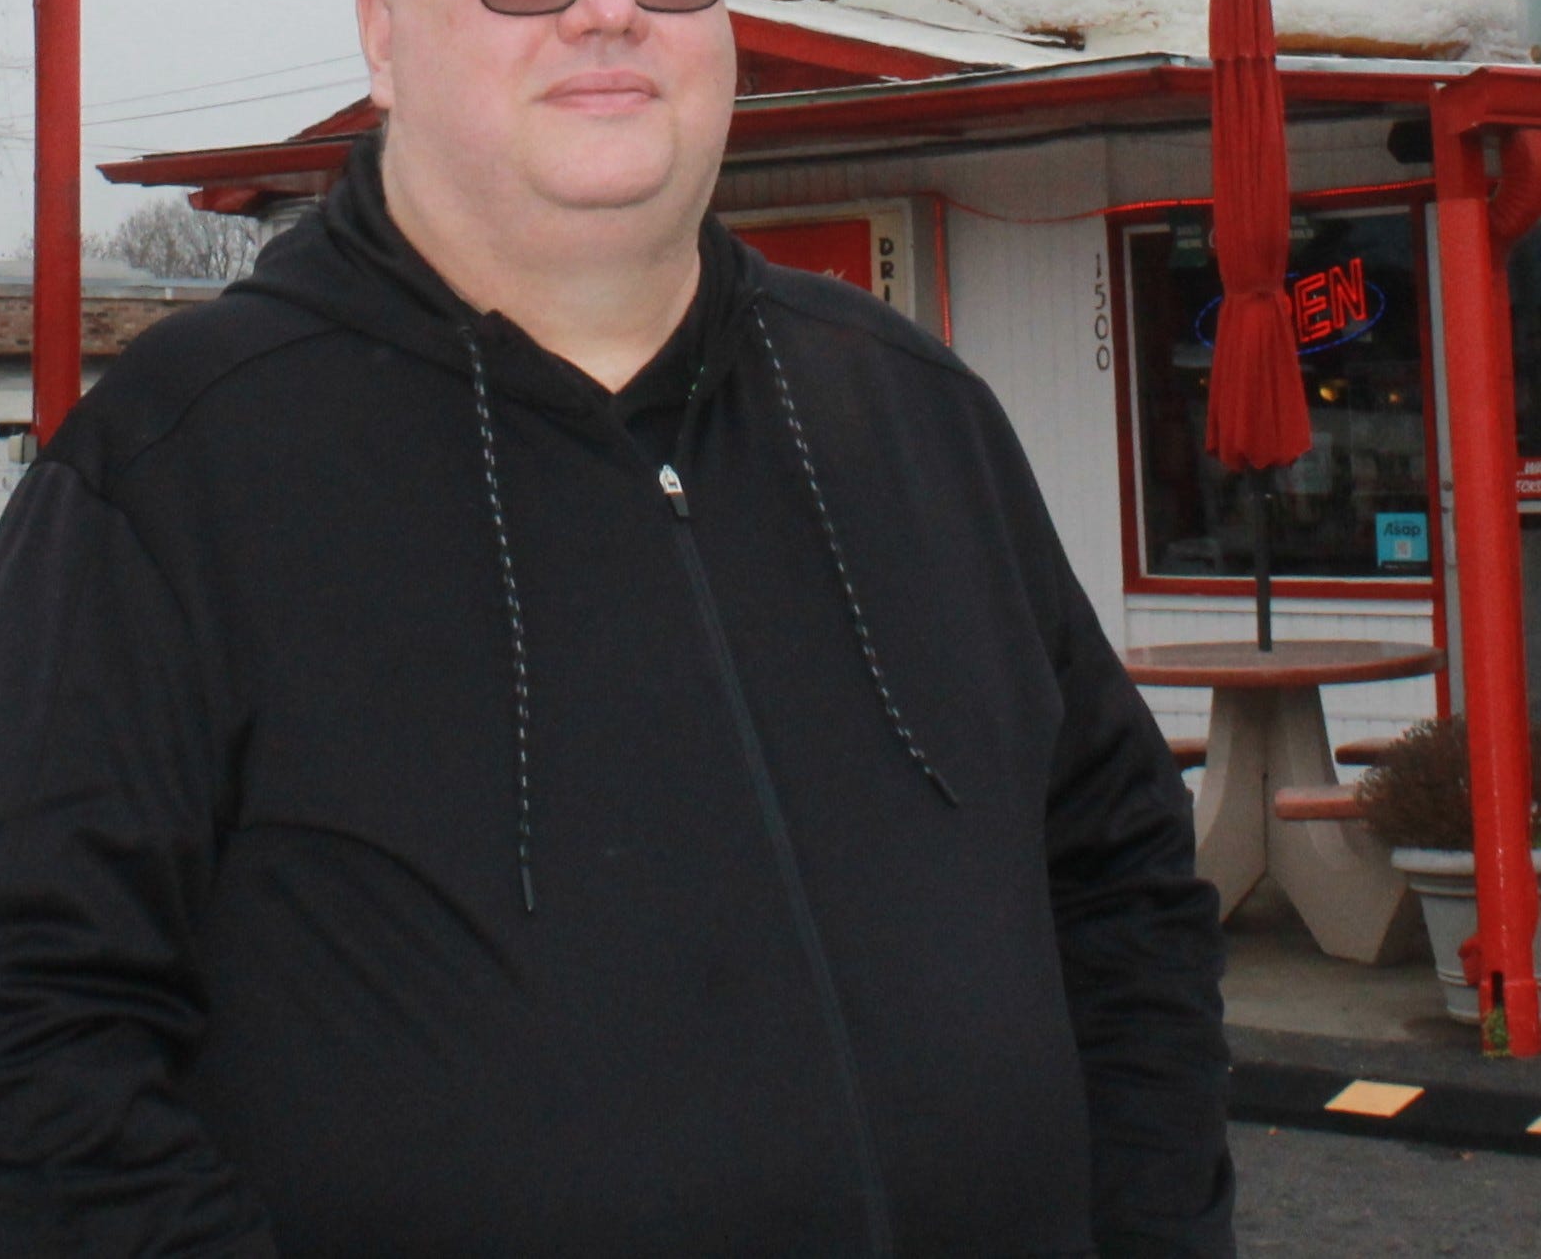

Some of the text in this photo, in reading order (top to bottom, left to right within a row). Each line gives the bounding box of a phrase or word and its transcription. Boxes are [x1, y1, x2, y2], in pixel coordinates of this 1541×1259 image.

[878, 237, 895, 302] DRI
[1093, 252, 1111, 371] 1500
[1283, 257, 1367, 343] EN
